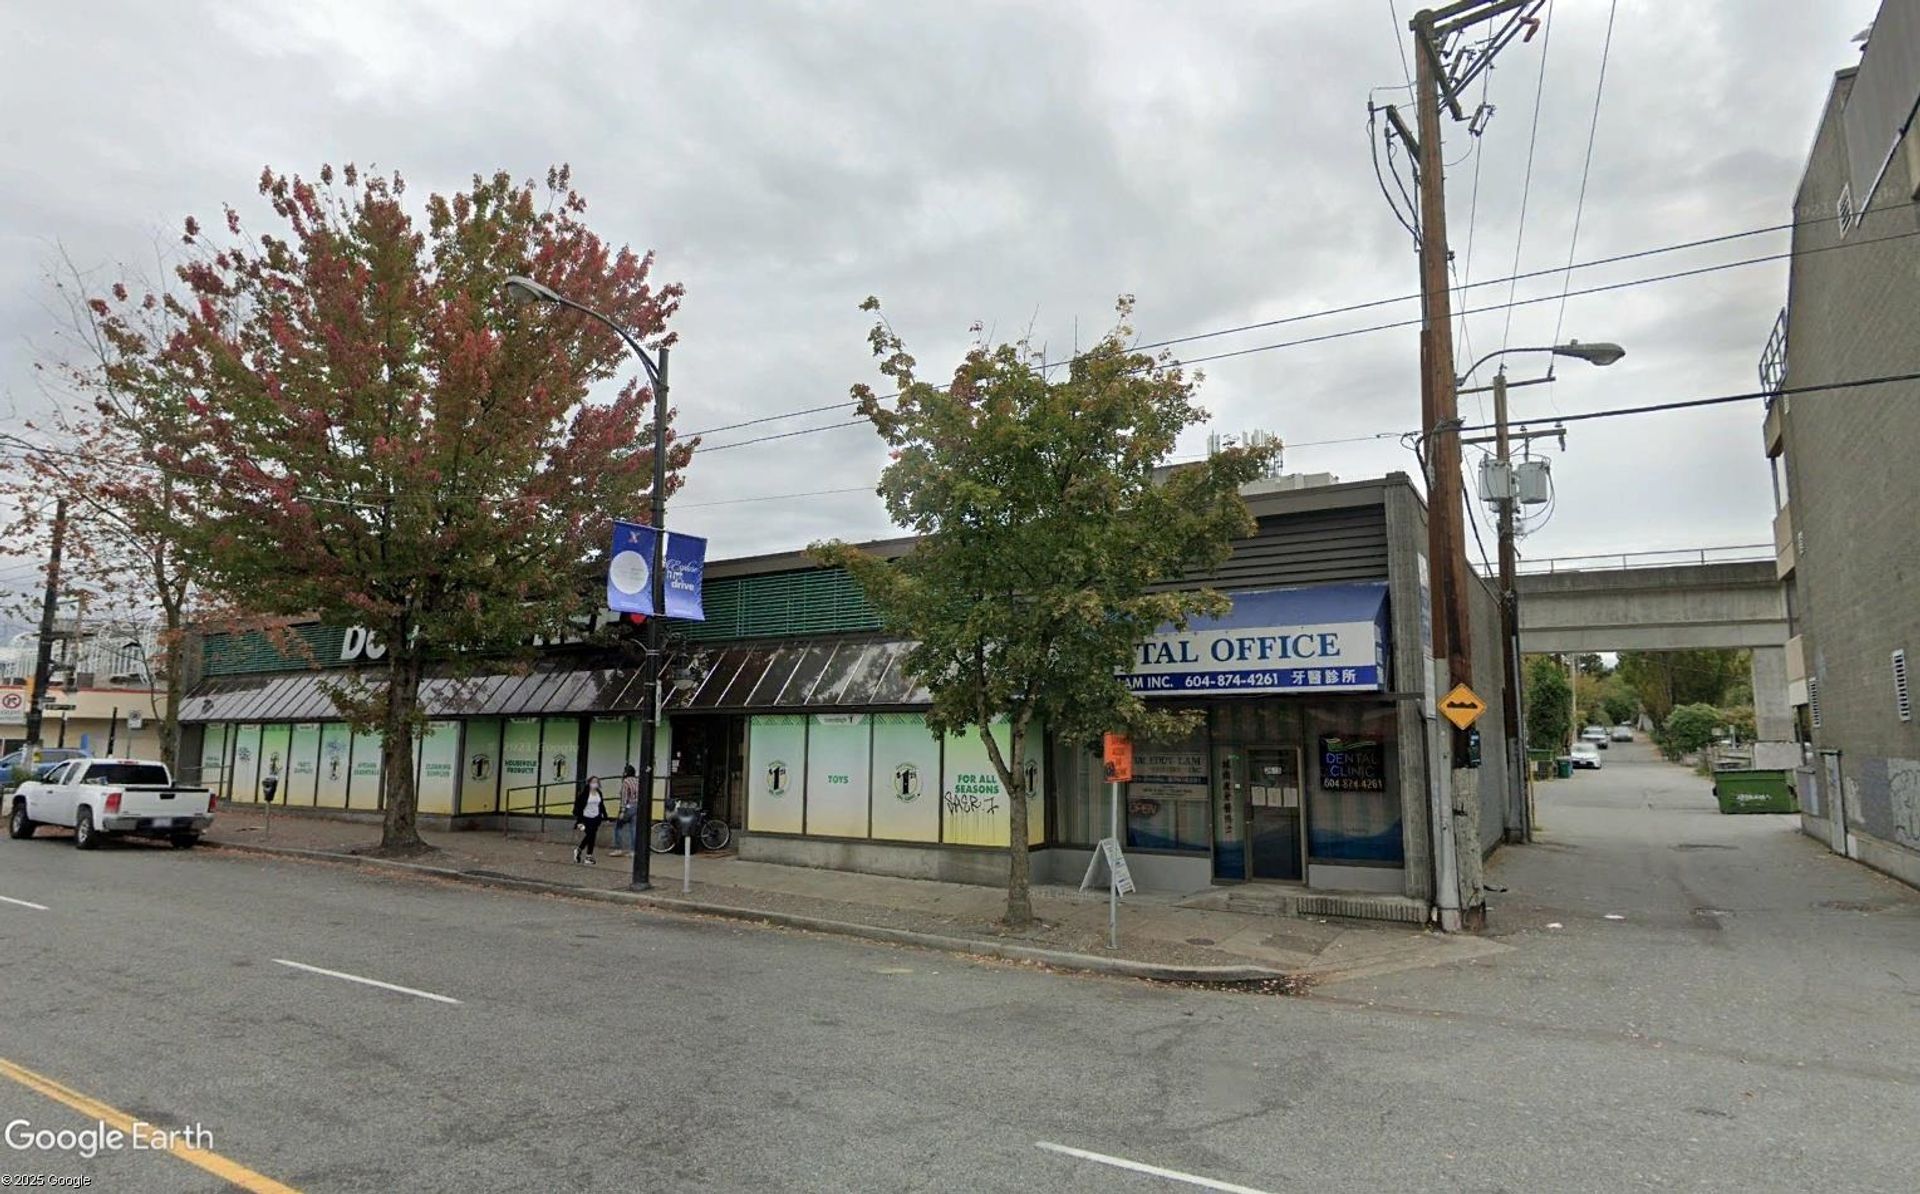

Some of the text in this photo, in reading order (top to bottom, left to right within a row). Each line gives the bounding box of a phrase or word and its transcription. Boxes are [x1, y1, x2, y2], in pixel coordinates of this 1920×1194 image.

[671, 581, 695, 592] drive
[1210, 633, 1341, 662] OFFICE
[1147, 675, 1174, 689] INC.
[1185, 673, 1279, 688] 604-874-4261
[1290, 668, 1358, 685] 牙醫診所
[1325, 752, 1377, 765] DENTAL
[1329, 764, 1376, 778] CLINIC
[827, 775, 849, 784] TOYS
[957, 775, 997, 784] FOR ALL
[955, 785, 1000, 794] SEASONS
